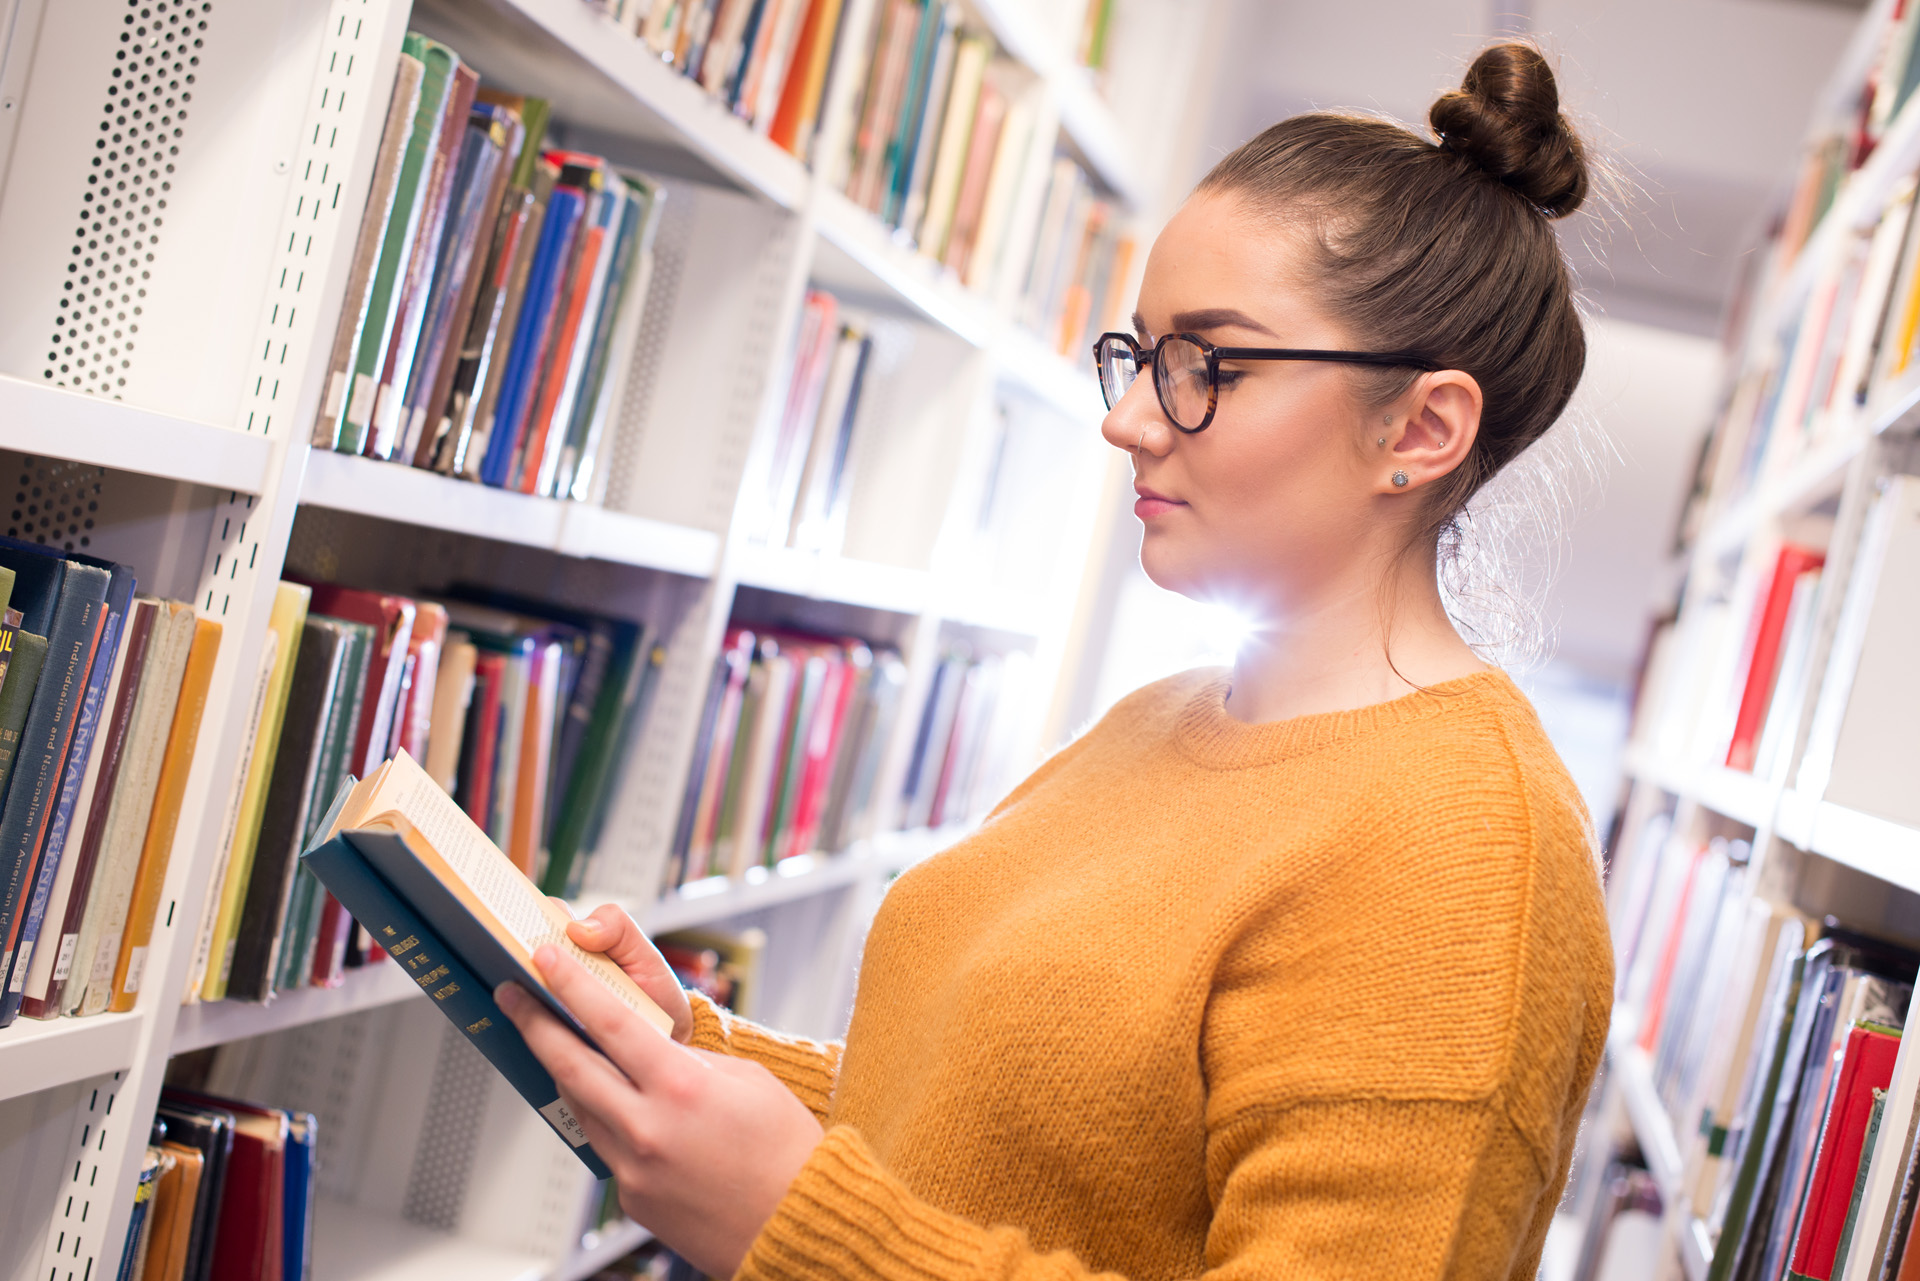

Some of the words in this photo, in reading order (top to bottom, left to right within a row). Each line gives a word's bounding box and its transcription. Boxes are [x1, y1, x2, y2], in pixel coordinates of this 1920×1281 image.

[80, 602, 91, 626] ARIELI
[52, 640, 83, 723] Individualism
[45, 726, 60, 750] and
[59, 684, 100, 804] HANNAH
[24, 753, 52, 828] Nationalism
[20, 831, 31, 845] in
[28, 809, 67, 920] ARENDT
[3, 848, 27, 908] American
[414, 952, 430, 965] THE
[433, 982, 461, 1001] NATIONS
[558, 1107, 569, 1119] JC
[562, 1117, 578, 1131] 249
